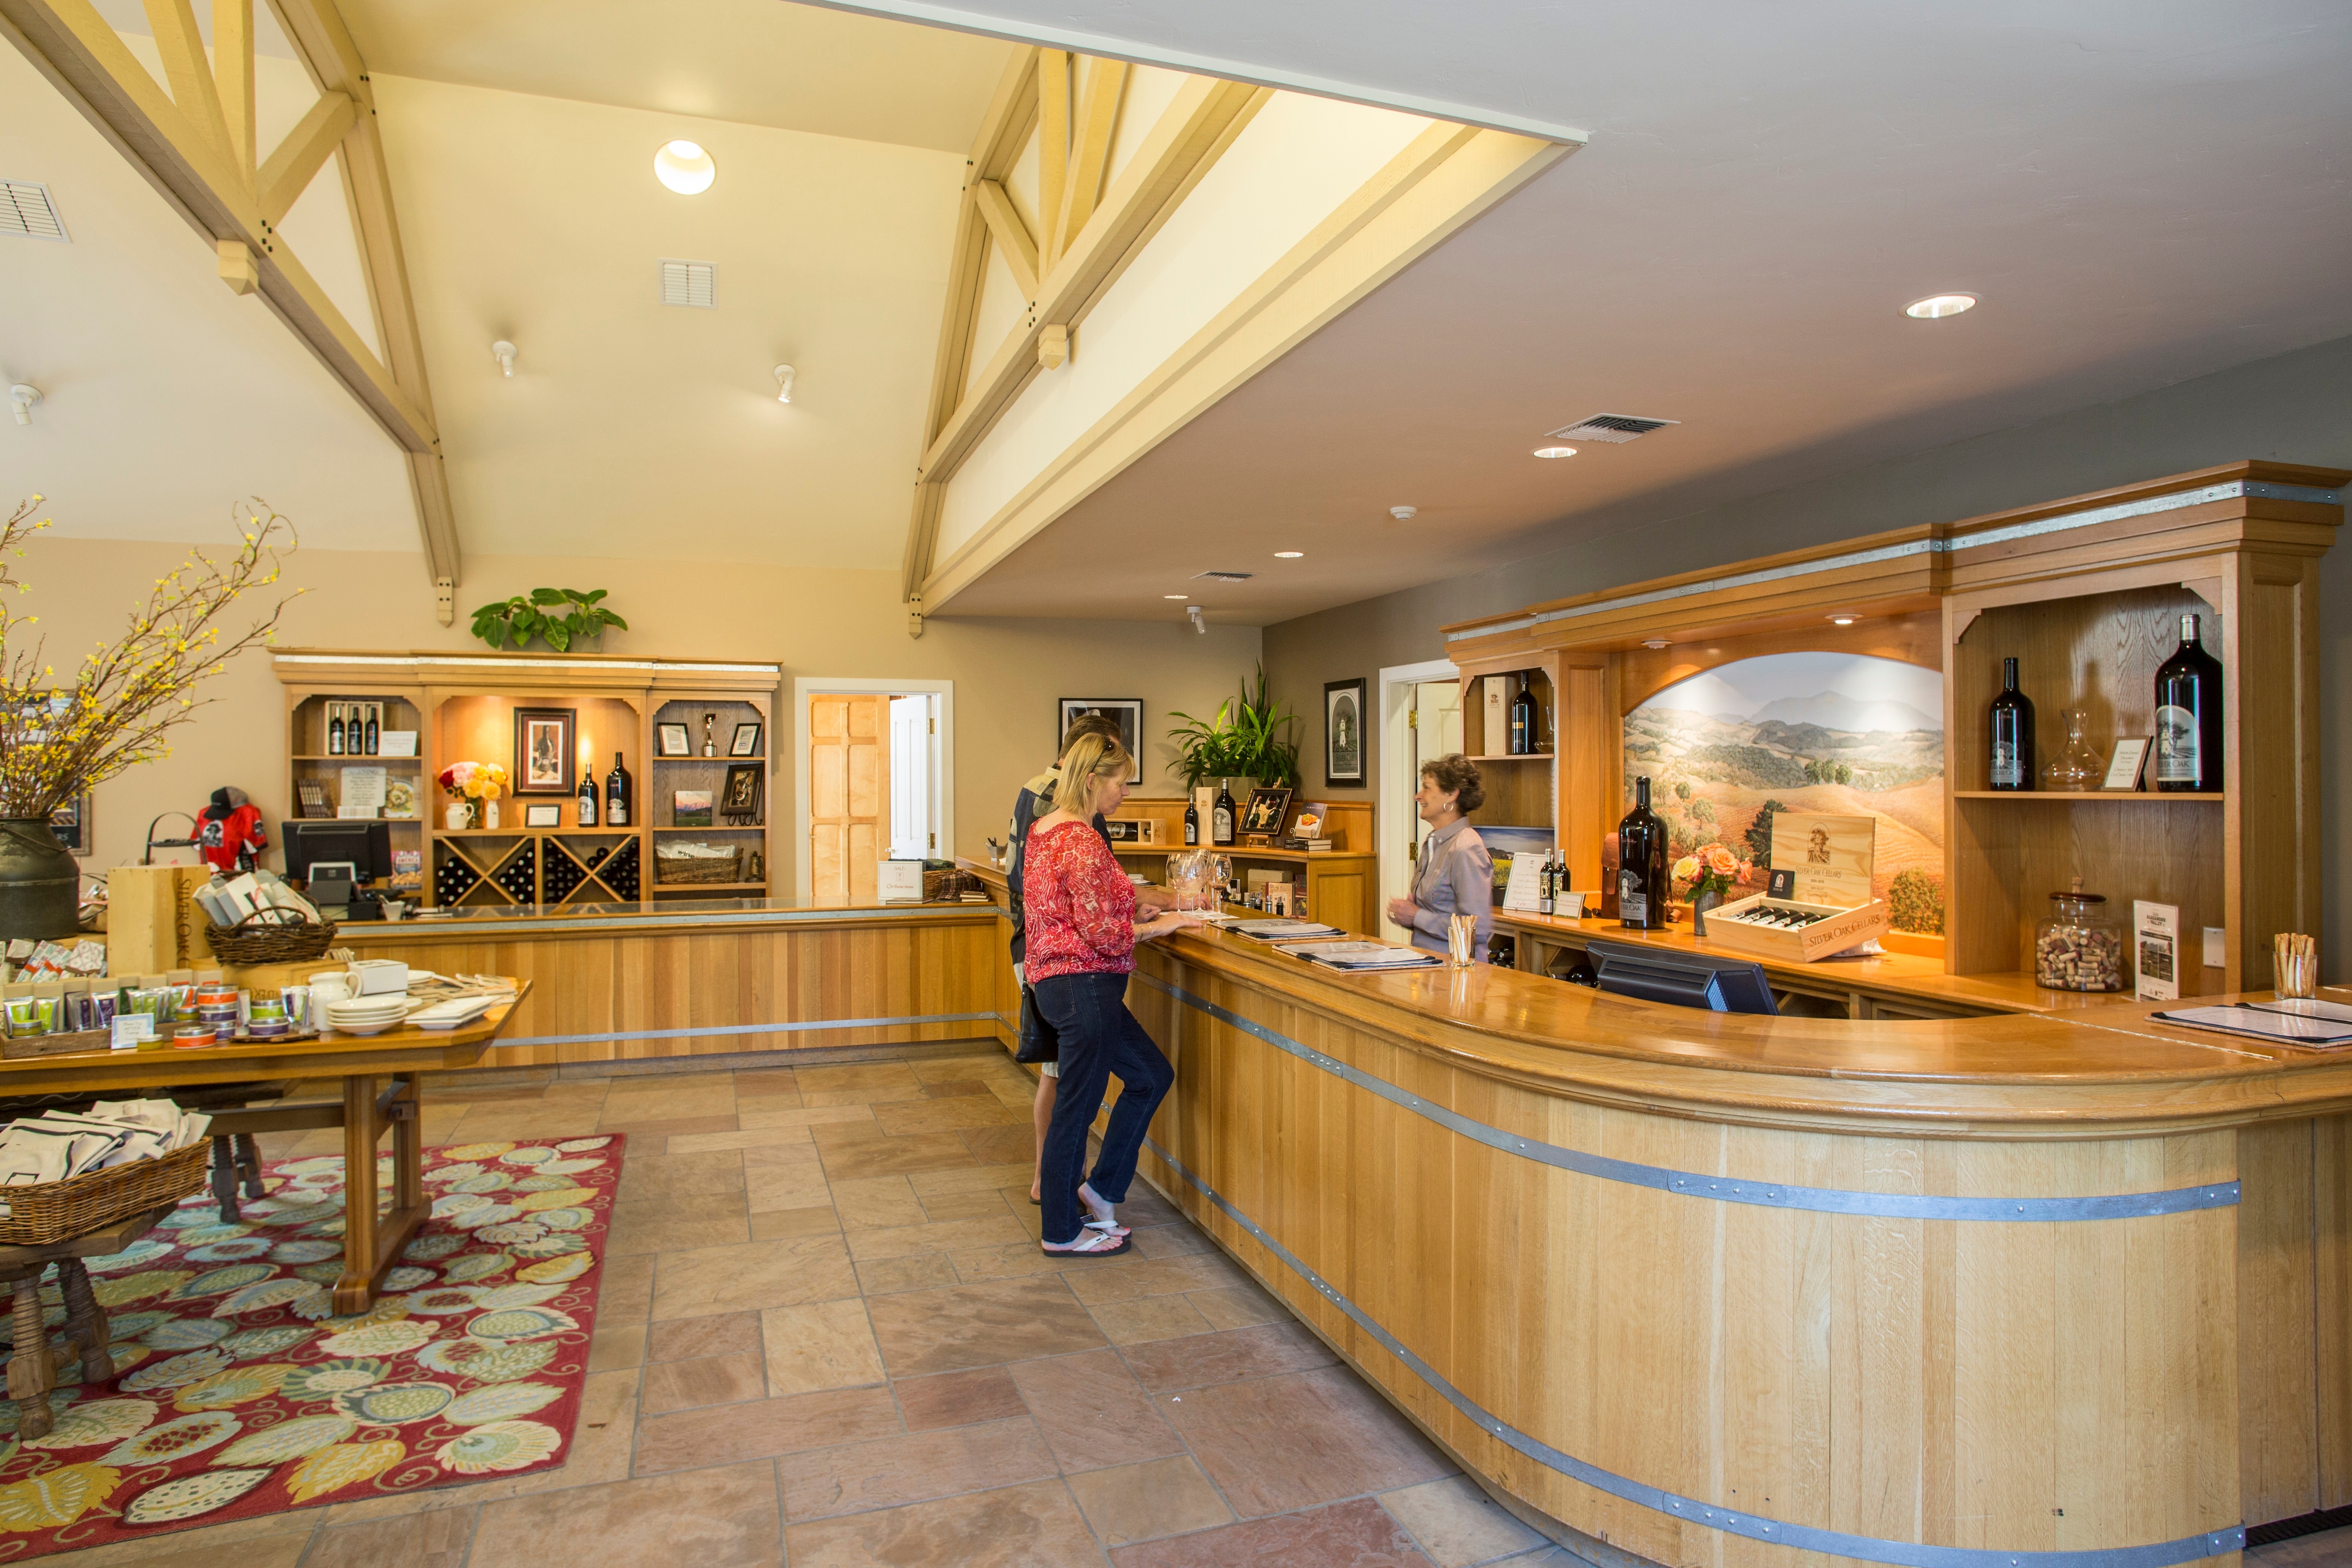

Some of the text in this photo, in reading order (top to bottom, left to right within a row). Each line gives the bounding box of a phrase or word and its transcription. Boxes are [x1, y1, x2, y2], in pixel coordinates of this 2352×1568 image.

[1795, 866, 1842, 879] SILVER OAK CELLARS
[177, 878, 192, 923] SILVER
[1810, 915, 1880, 947] SILVER OAK CELLARS
